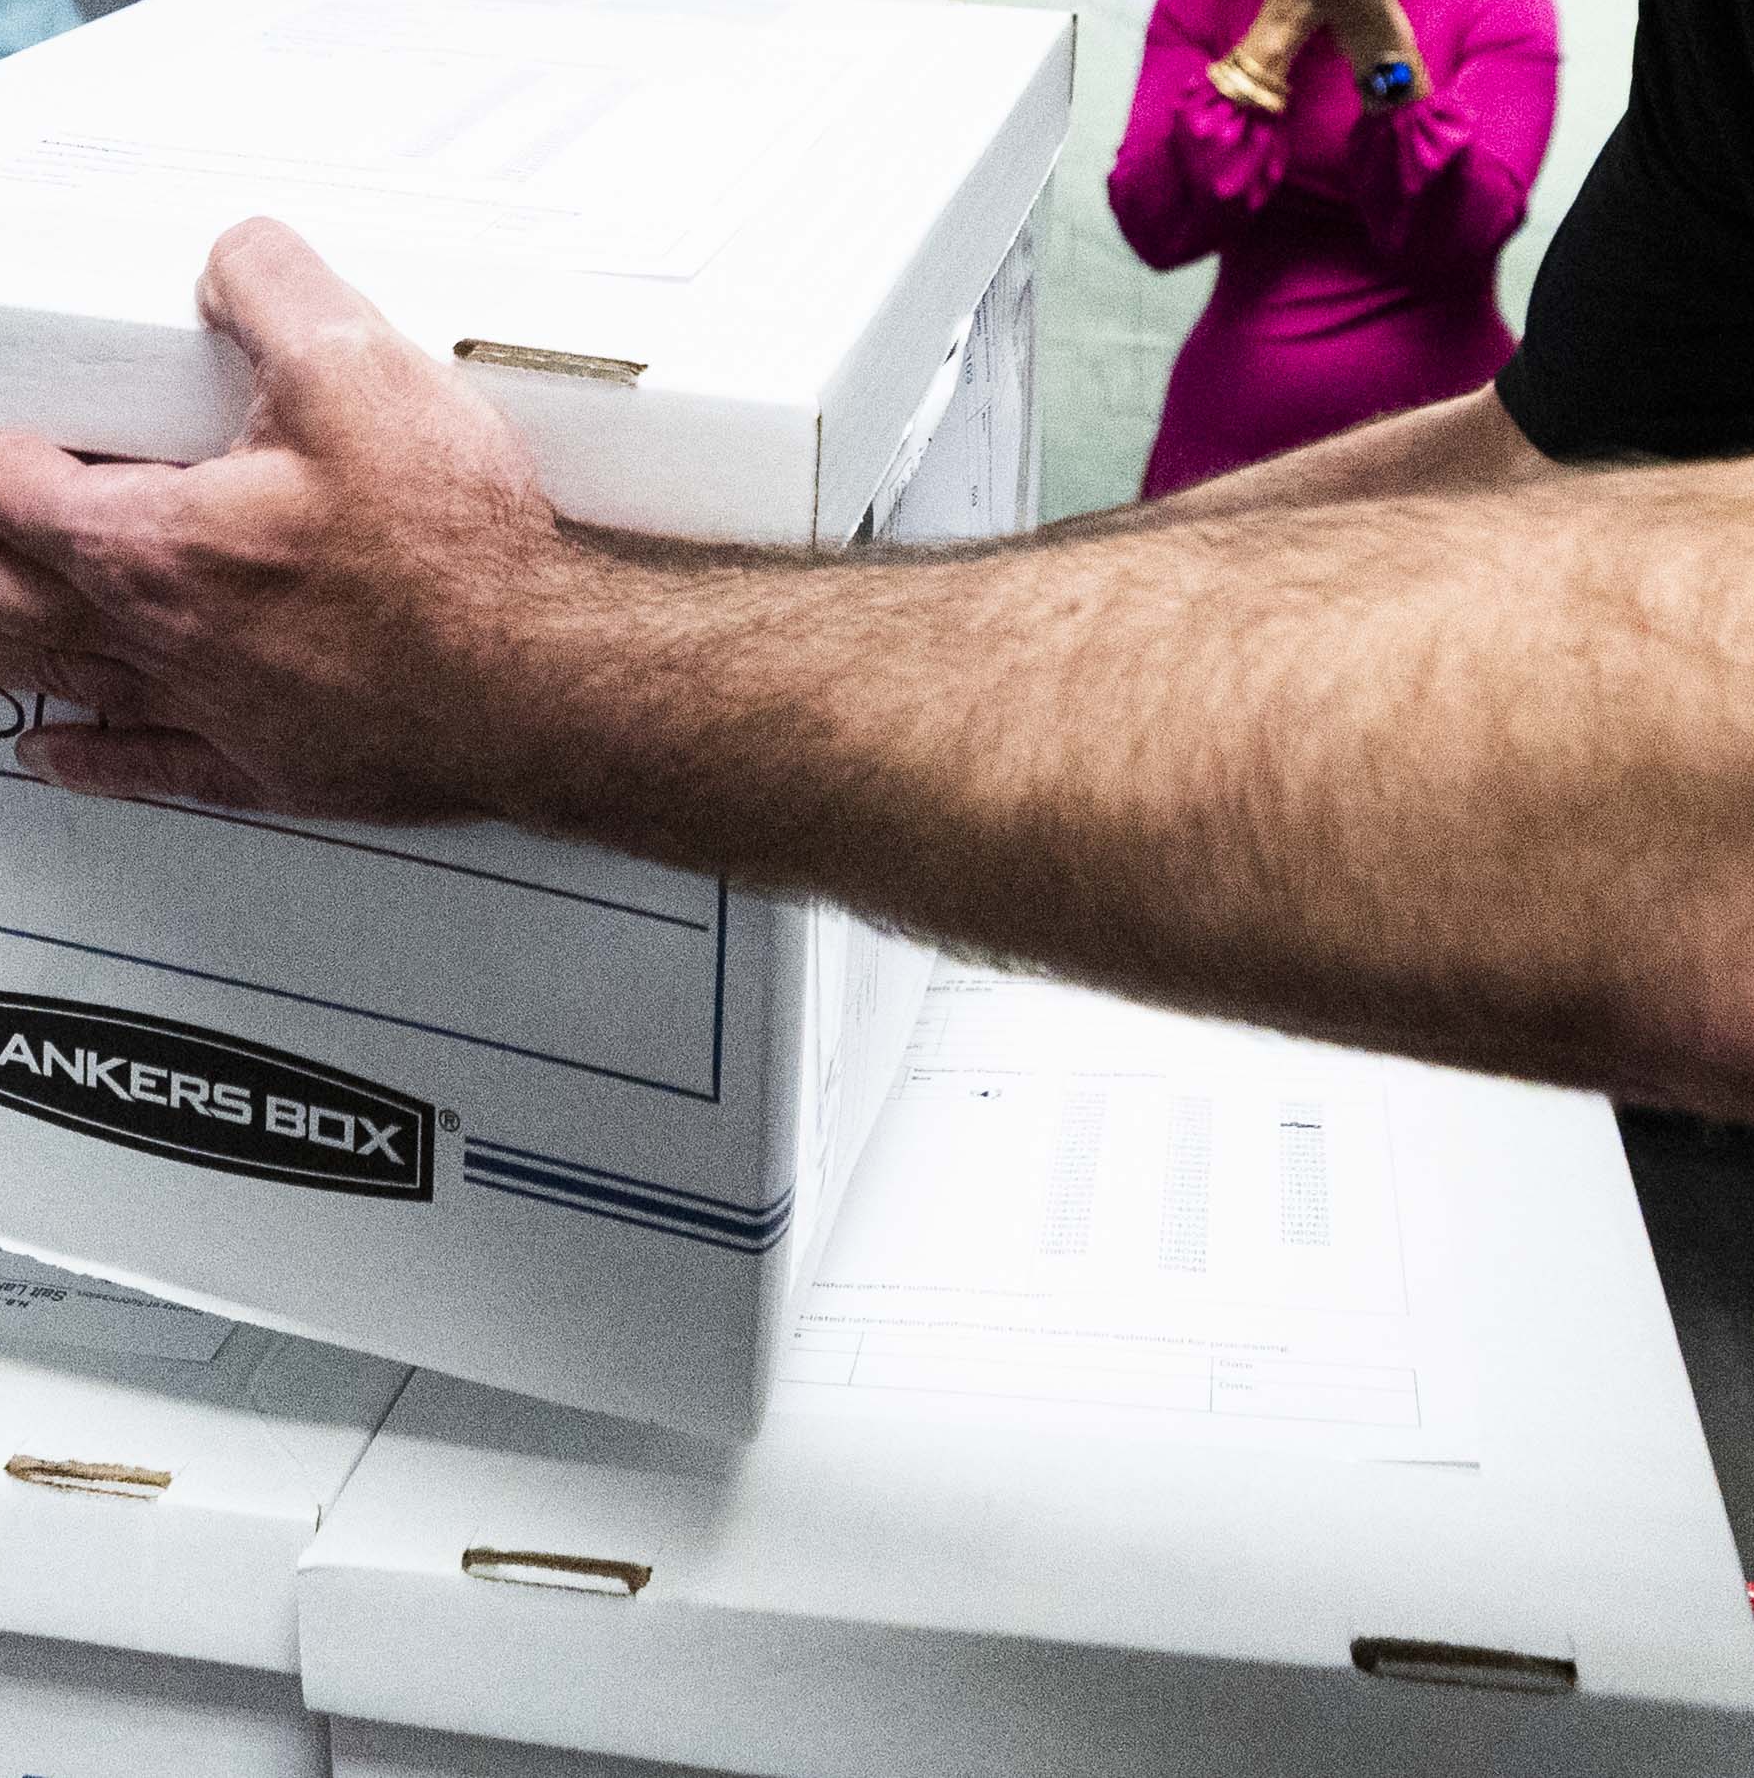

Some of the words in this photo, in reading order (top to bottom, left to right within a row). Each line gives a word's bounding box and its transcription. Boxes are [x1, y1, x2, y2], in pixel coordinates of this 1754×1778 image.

[264, 1092, 407, 1165] BOX
[30, 1286, 68, 1302] Salt
[4, 1298, 31, 1309] H.B.
